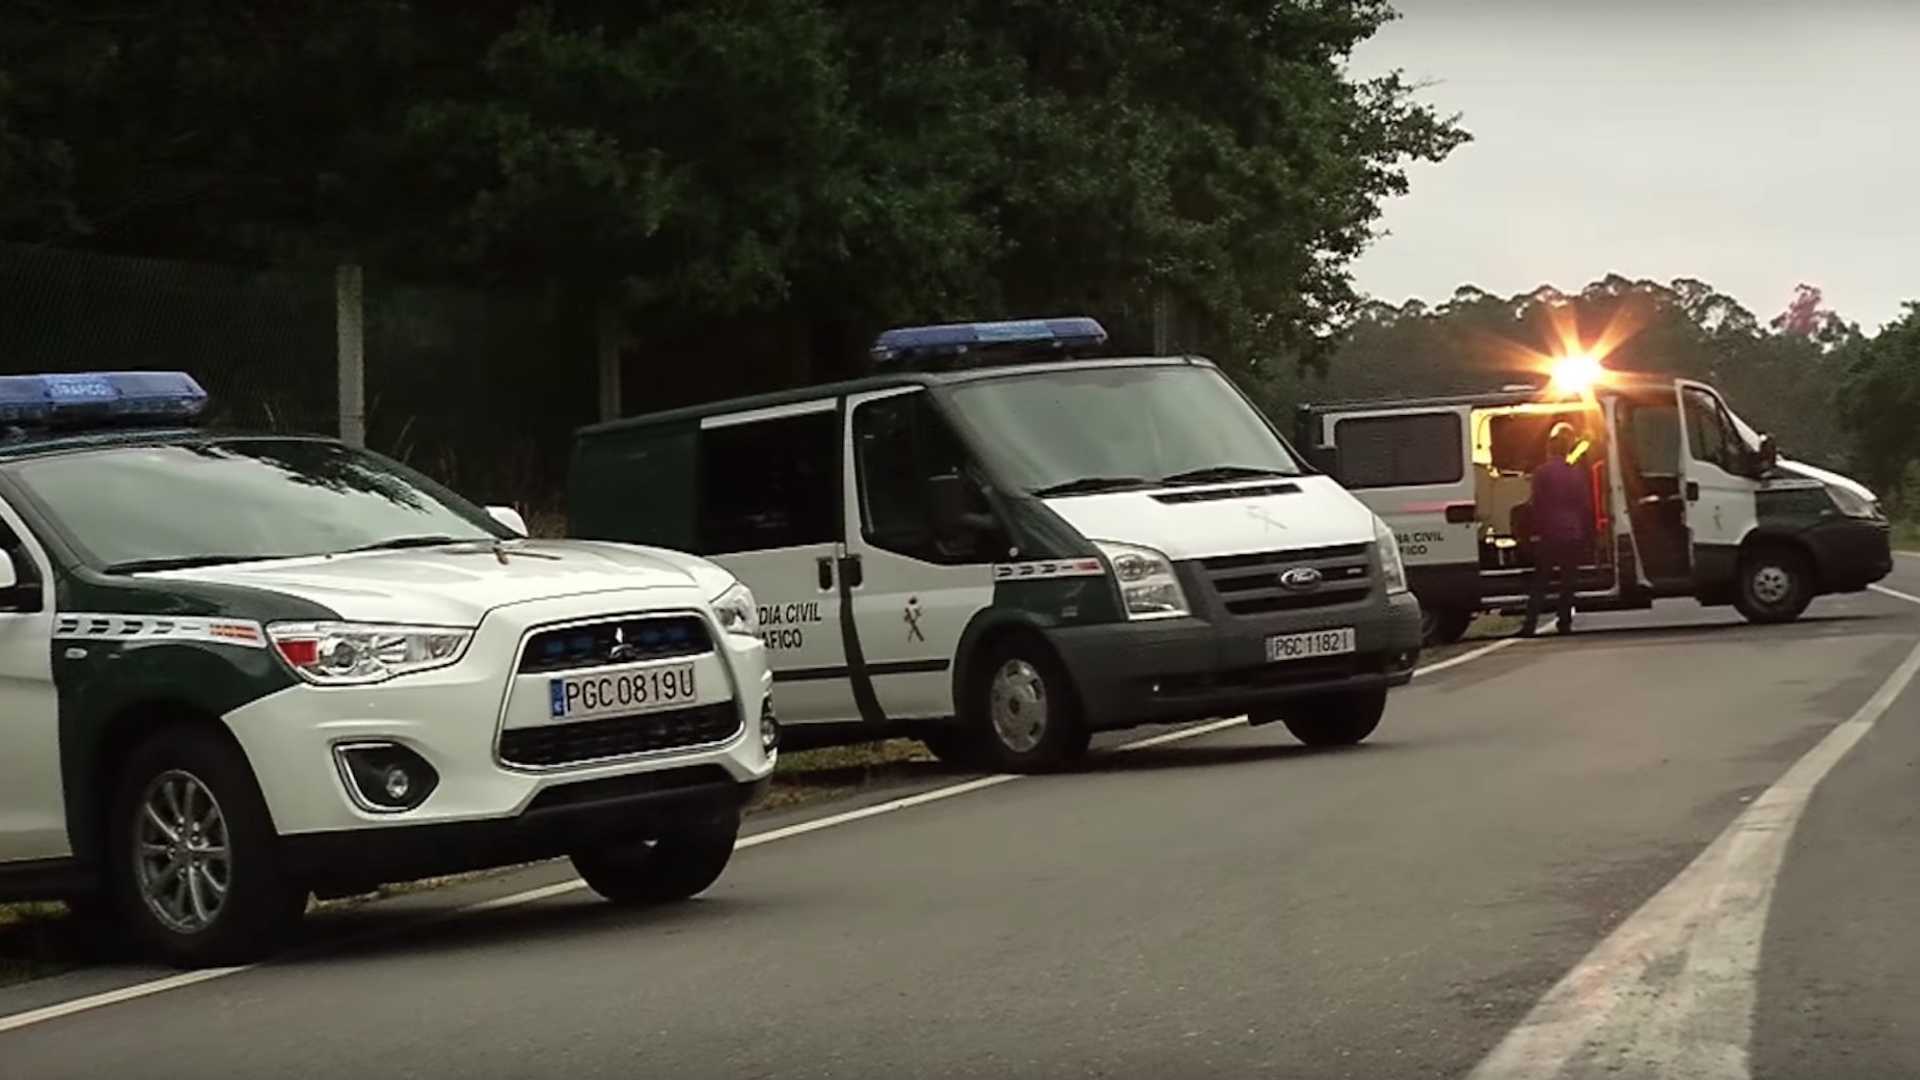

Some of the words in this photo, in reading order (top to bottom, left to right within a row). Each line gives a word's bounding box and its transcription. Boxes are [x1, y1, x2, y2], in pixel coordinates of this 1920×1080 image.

[1414, 532, 1444, 542] CIVIL
[756, 605, 781, 625] DIA
[786, 602, 822, 623] CIVIL
